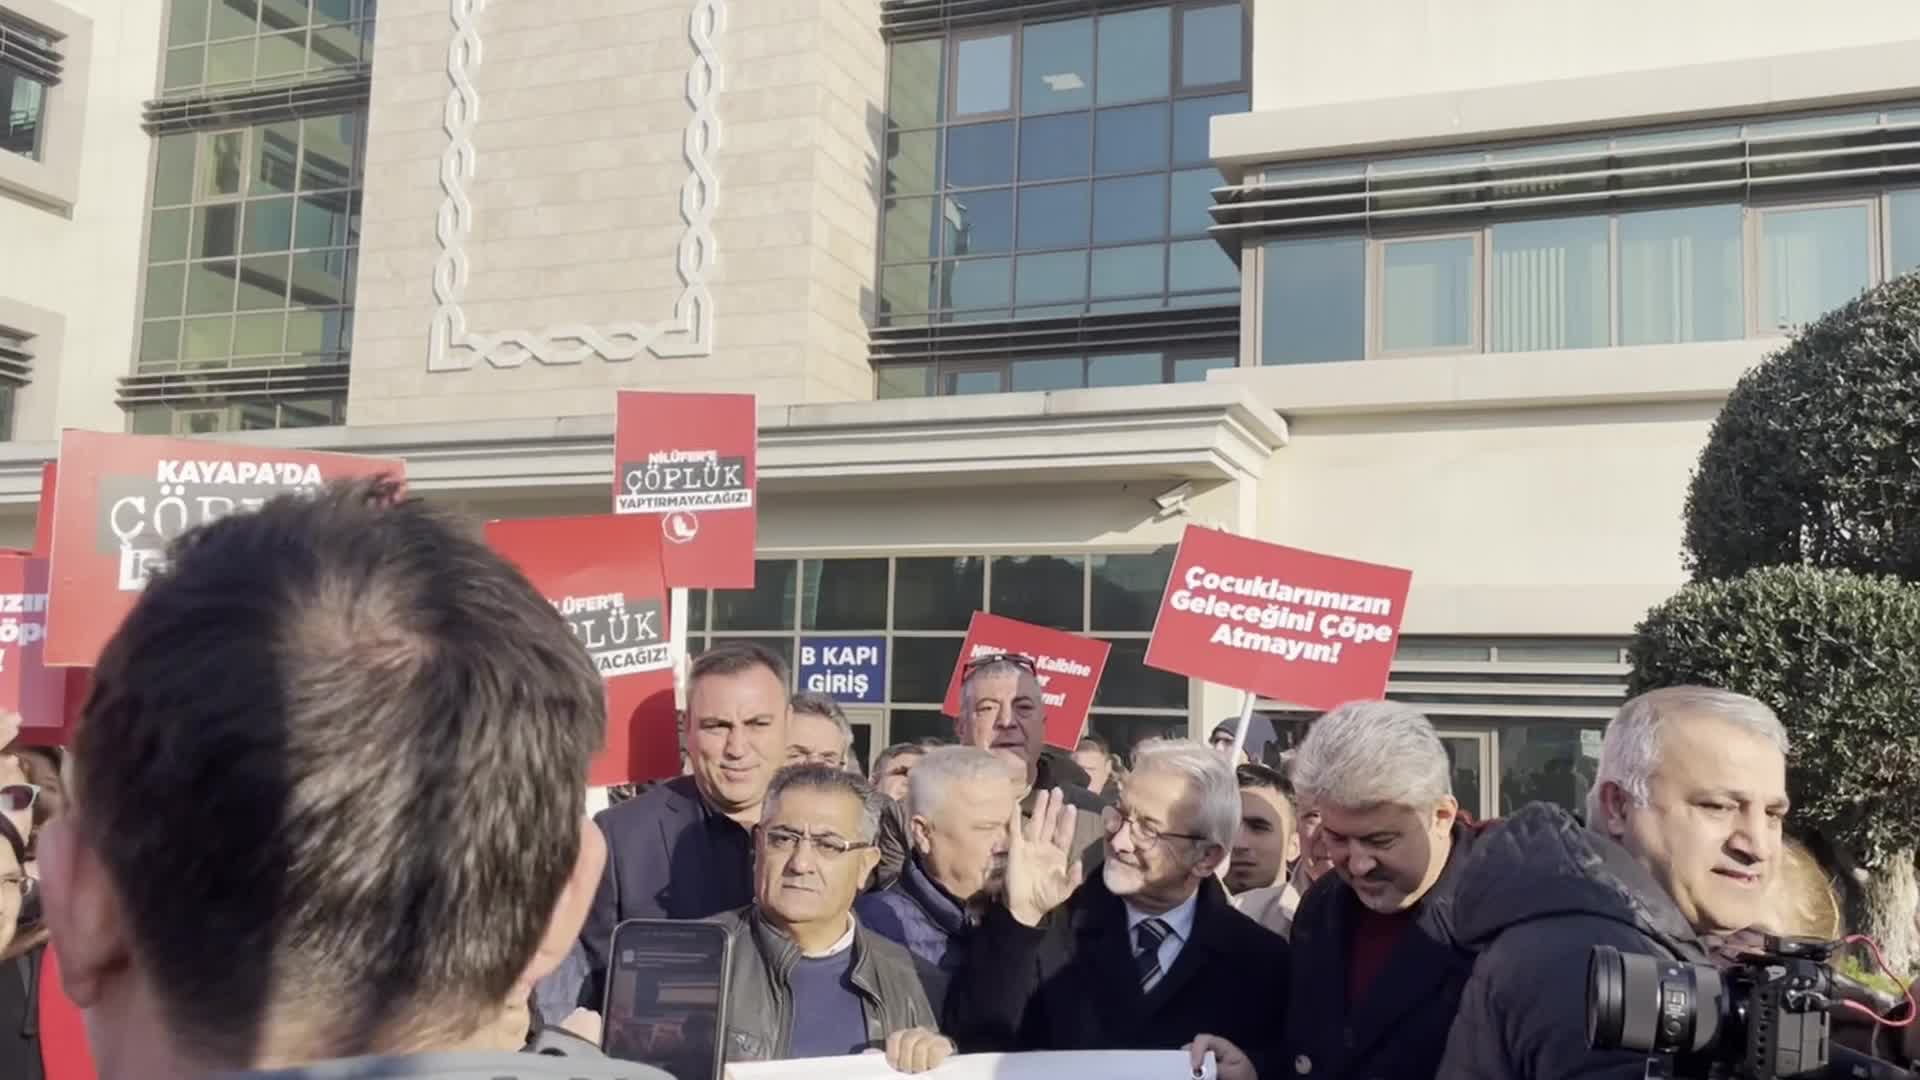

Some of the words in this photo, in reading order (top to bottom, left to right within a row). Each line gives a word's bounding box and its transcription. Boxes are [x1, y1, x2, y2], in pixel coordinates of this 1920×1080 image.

[156, 460, 322, 485] KAYAPA'DA
[624, 461, 743, 495] ÇÖPLÜK
[617, 491, 749, 511] YAPTIRMAYACAĞIZ!
[1184, 566, 1391, 615] Çocuklarımızın
[1170, 590, 1315, 632] Geleceğini
[1319, 614, 1393, 643] Çöpe
[801, 646, 816, 665] B
[822, 646, 877, 665] KAPI
[1210, 623, 1343, 664] Atmayın!
[807, 669, 869, 698] GİRİŞ
